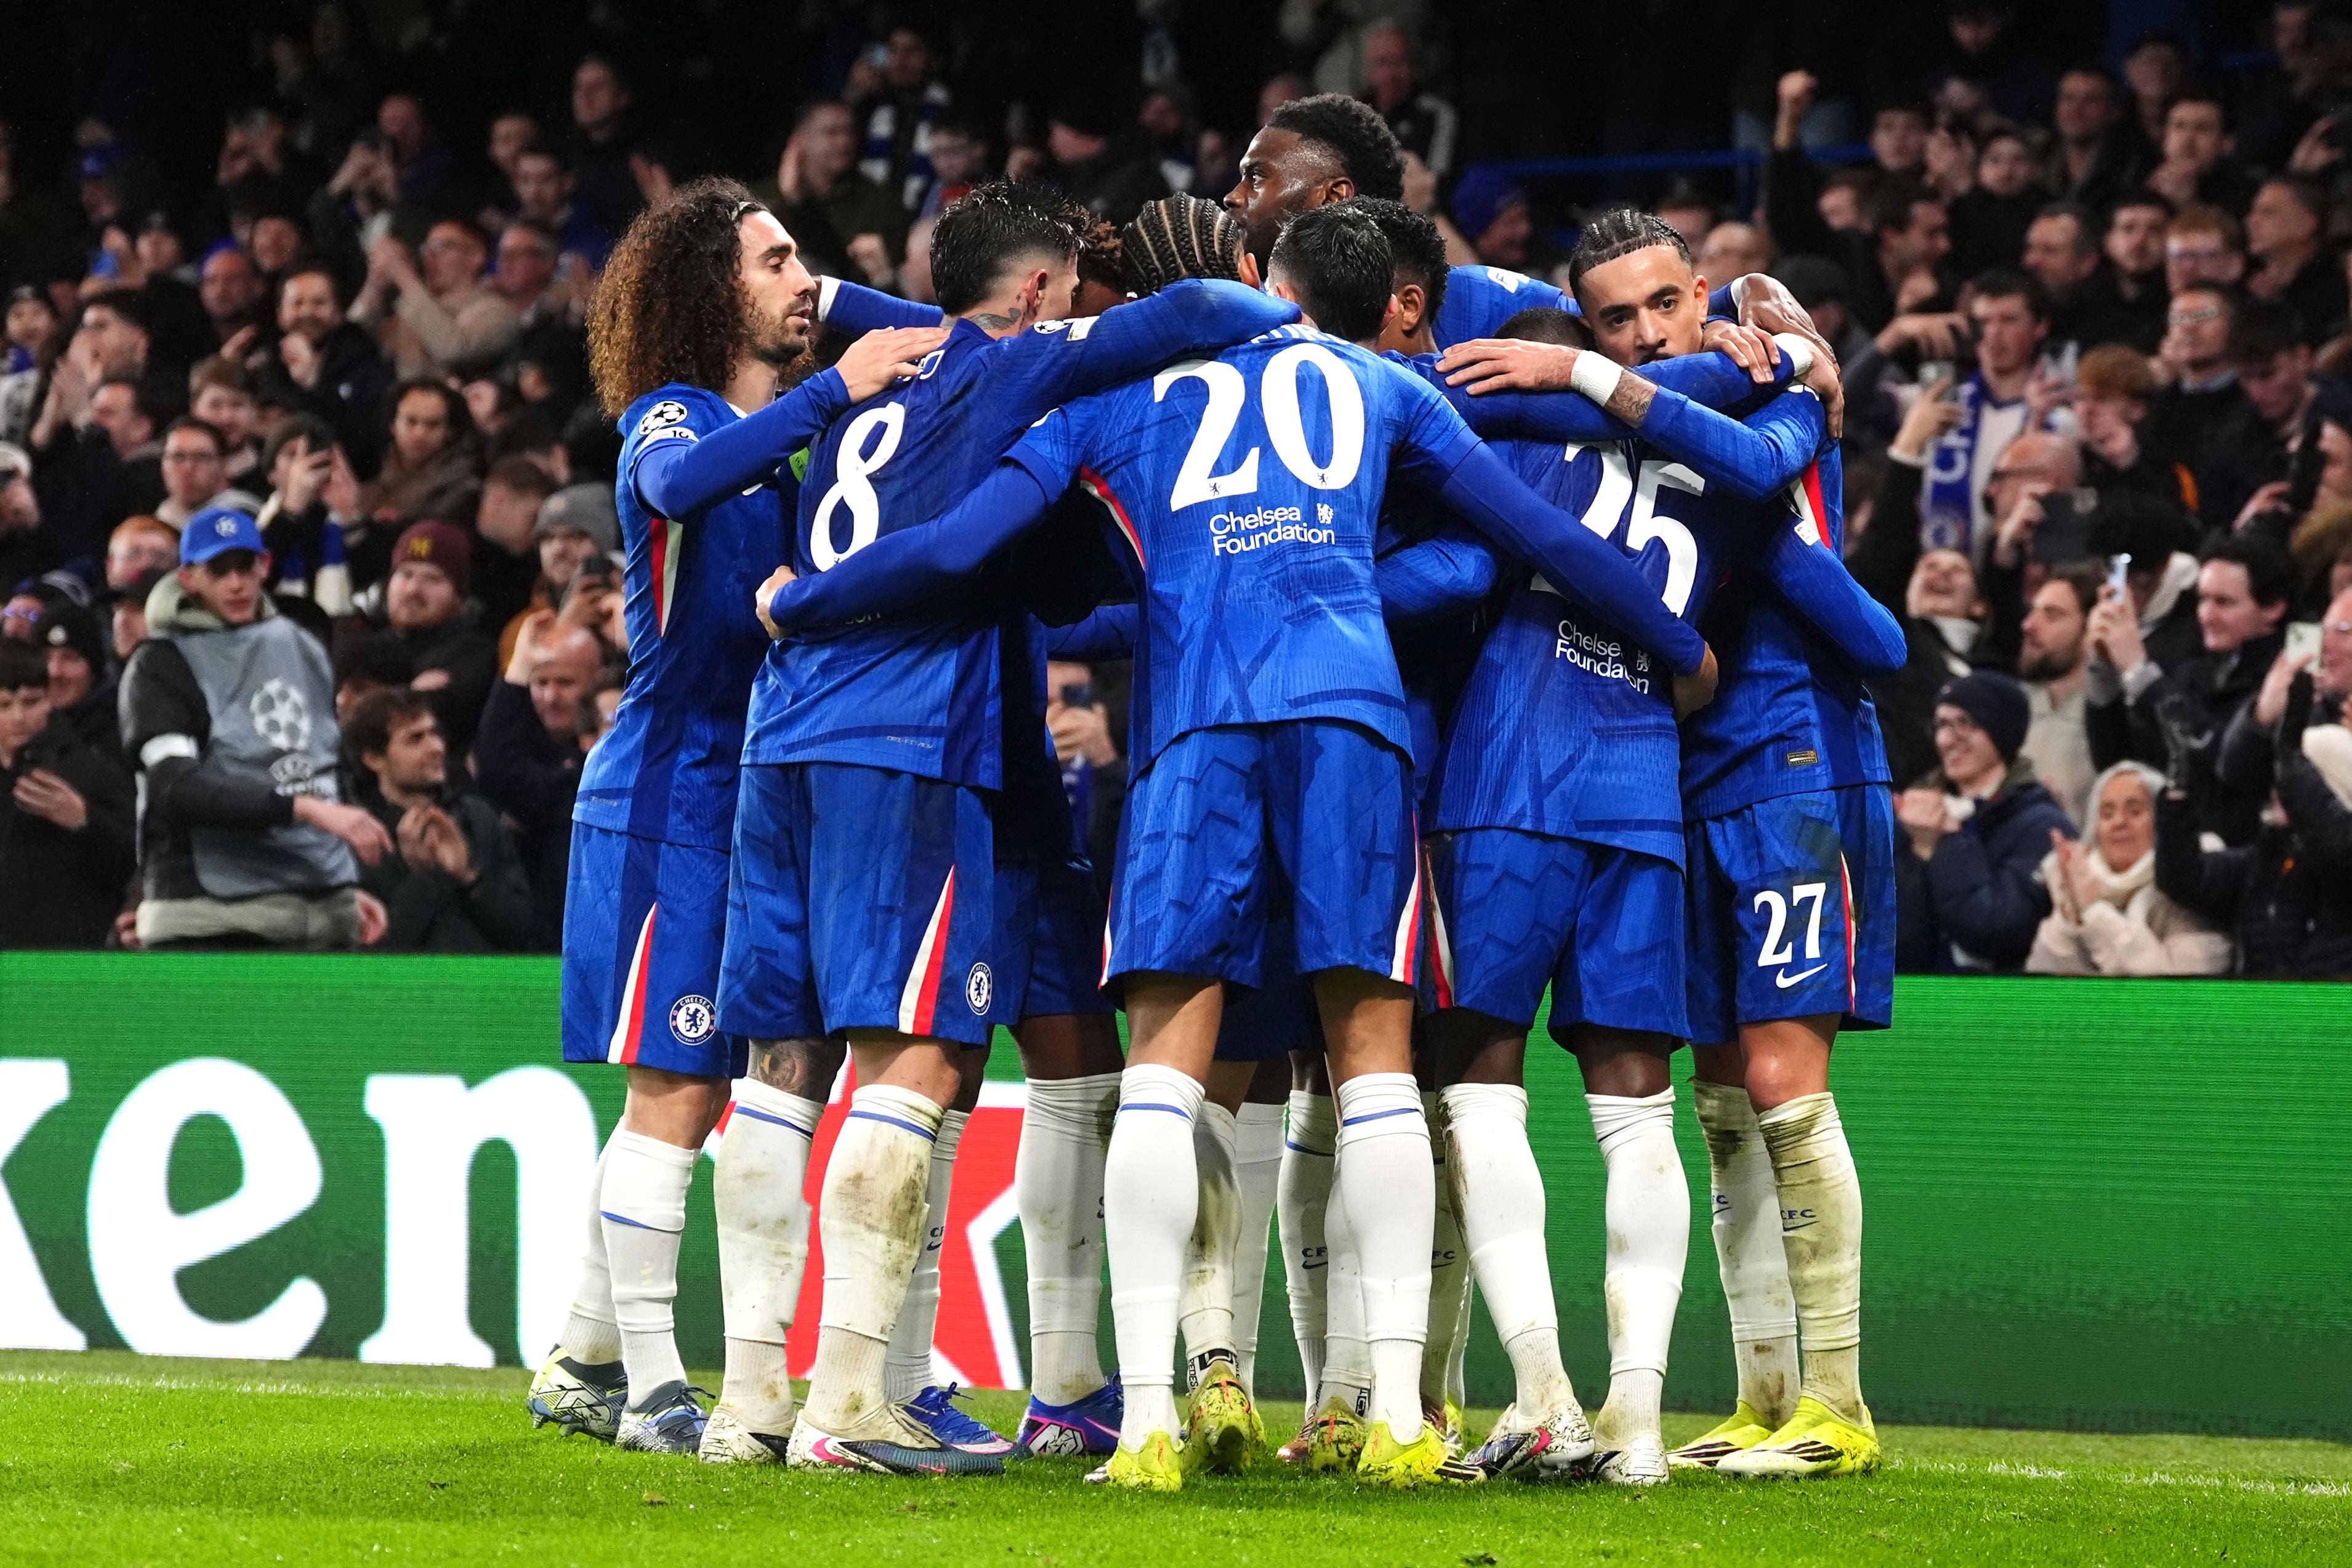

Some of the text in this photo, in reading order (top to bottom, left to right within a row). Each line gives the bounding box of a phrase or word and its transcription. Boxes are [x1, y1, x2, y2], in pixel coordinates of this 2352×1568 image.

[1153, 342, 1365, 512] 20
[810, 401, 906, 573] 8
[1209, 506, 1301, 535] Chelsea
[1212, 521, 1335, 557] Foundation
[1531, 441, 1706, 618] 25
[1558, 619, 1625, 660] Chelse
[1754, 882, 1827, 967] 27
[679, 997, 711, 1010] CHELSEA
[1302, 1247, 1327, 1257] CF
[1432, 1250, 1455, 1260] FC
